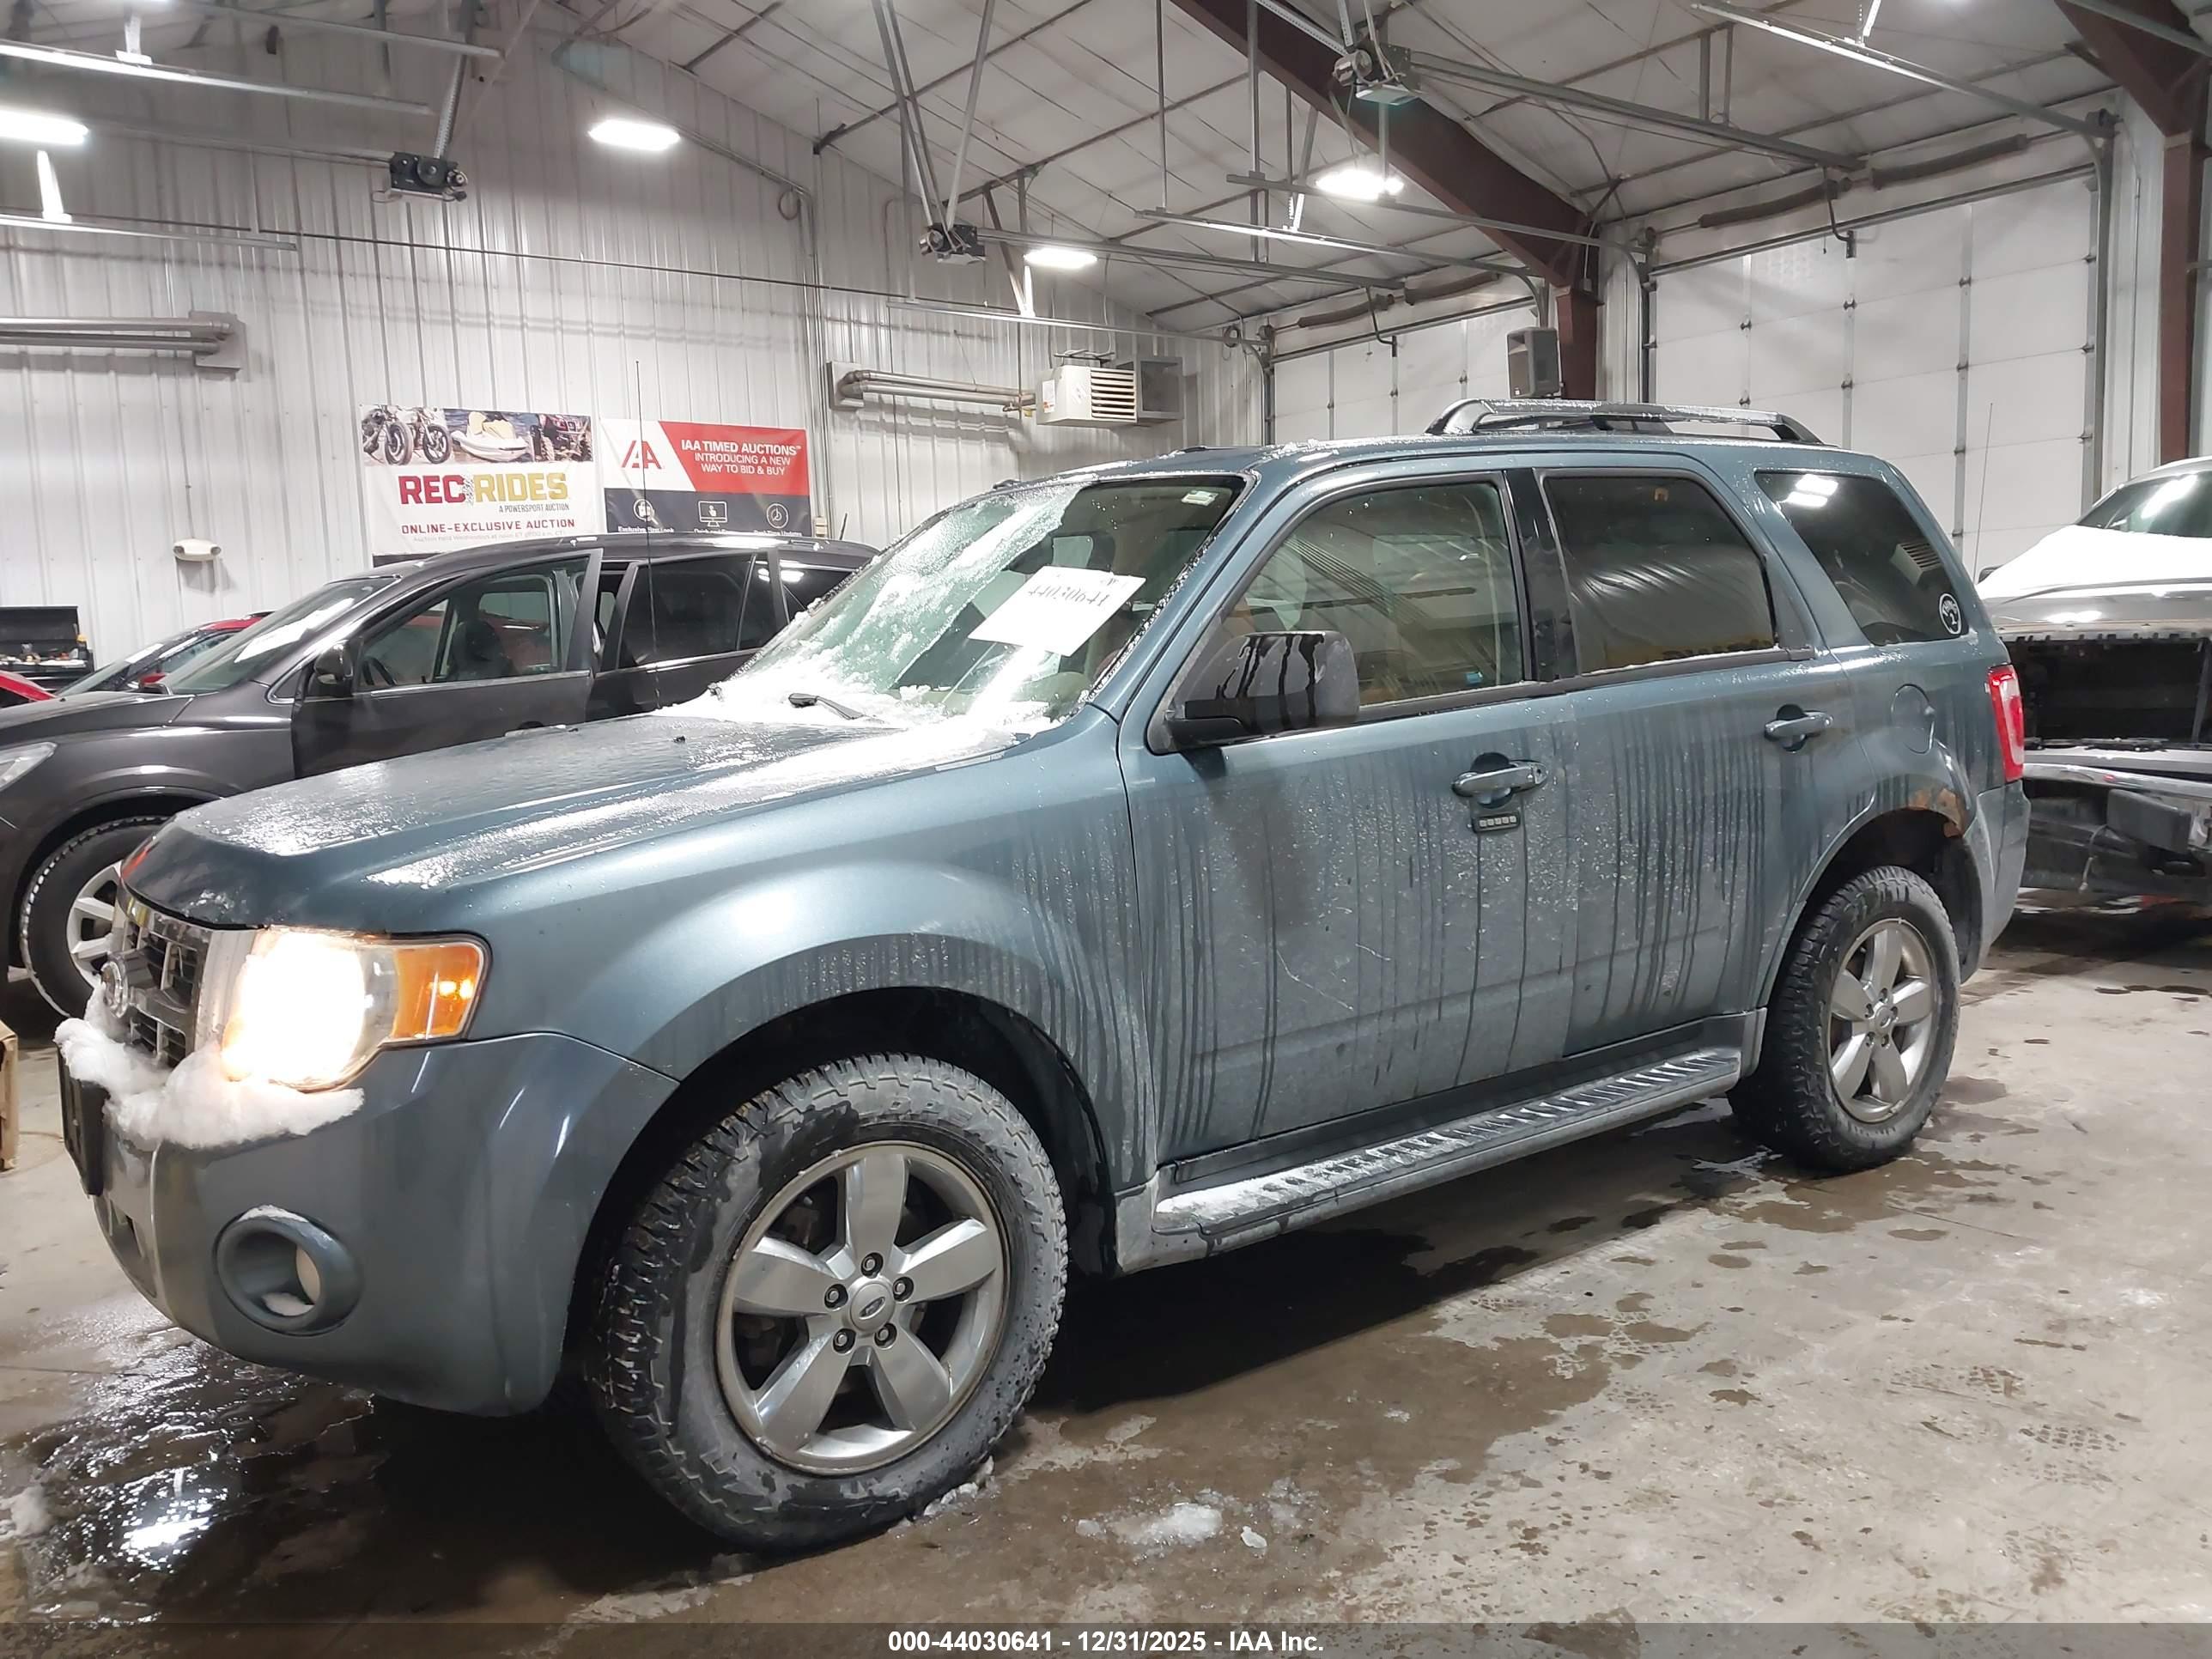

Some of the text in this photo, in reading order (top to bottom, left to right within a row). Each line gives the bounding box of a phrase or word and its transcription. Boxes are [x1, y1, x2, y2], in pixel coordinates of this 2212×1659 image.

[681, 440, 702, 451] IAA
[702, 441, 738, 453] TIMED
[695, 453, 791, 465] INTRODUCING A NEW
[701, 463, 786, 476] WAY TO BID & BUY
[398, 472, 568, 505] REC RIDES
[498, 502, 569, 514] A POWERSPORT AUCTION
[401, 520, 522, 535] ONLINE-EXCLUSIVE
[526, 519, 575, 530] AUCTION
